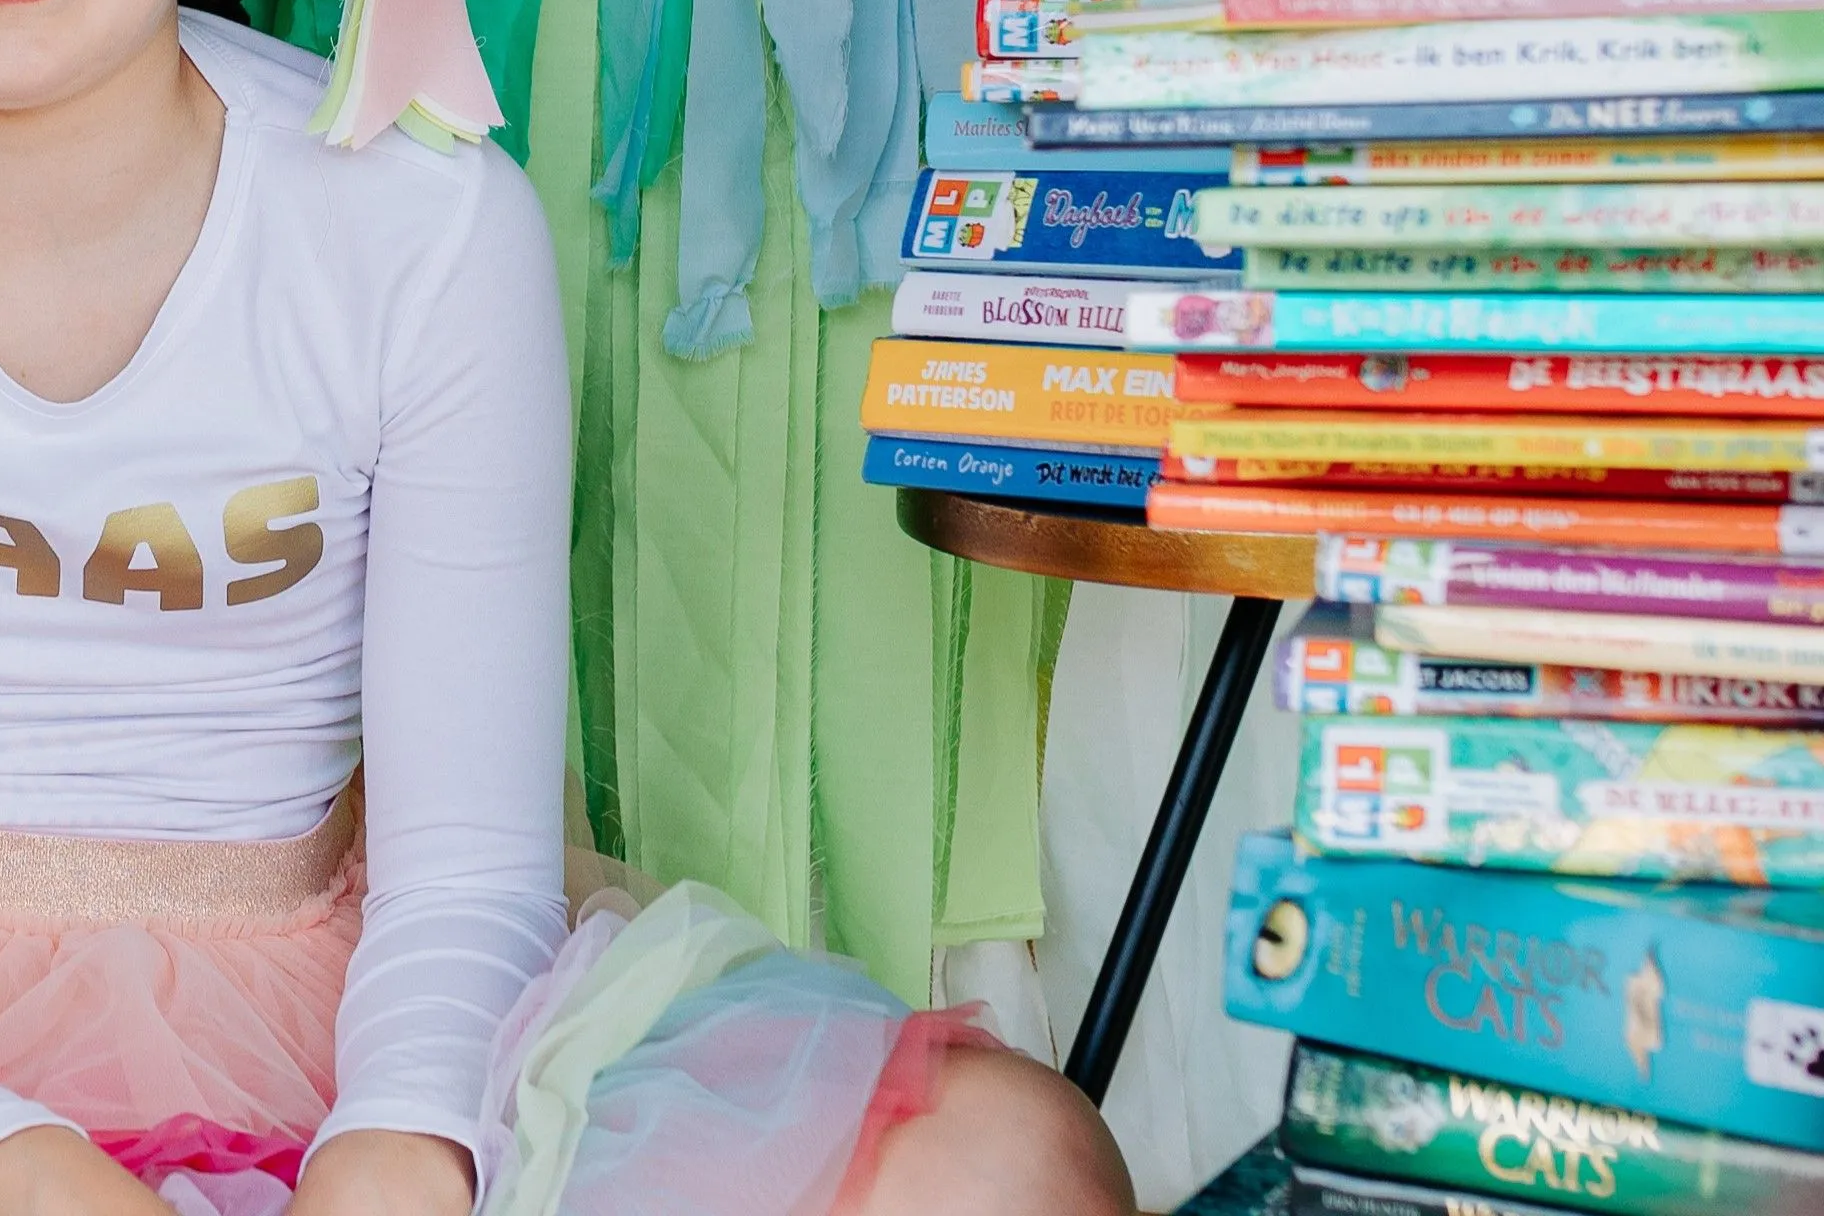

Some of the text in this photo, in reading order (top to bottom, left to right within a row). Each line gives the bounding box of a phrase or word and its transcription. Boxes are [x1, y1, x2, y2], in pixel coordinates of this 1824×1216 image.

[953, 118, 1012, 137] Marlies
[1586, 99, 1661, 128] NEE
[1042, 187, 1143, 248] Dagboek
[931, 290, 963, 304] BABETTE
[981, 295, 1126, 335] BLOSSOM HILL
[920, 359, 988, 385] JAMES
[1042, 364, 1116, 396] MAX
[886, 382, 1015, 412] PATTERSON
[1049, 399, 1099, 424] REDT
[893, 446, 1015, 486] Corien Oranje
[1389, 899, 1613, 1000] WARRIOR
[1424, 962, 1566, 1050] CATS
[1449, 1074, 1663, 1153] WARRIOR
[1477, 1121, 1618, 1199] CATS
